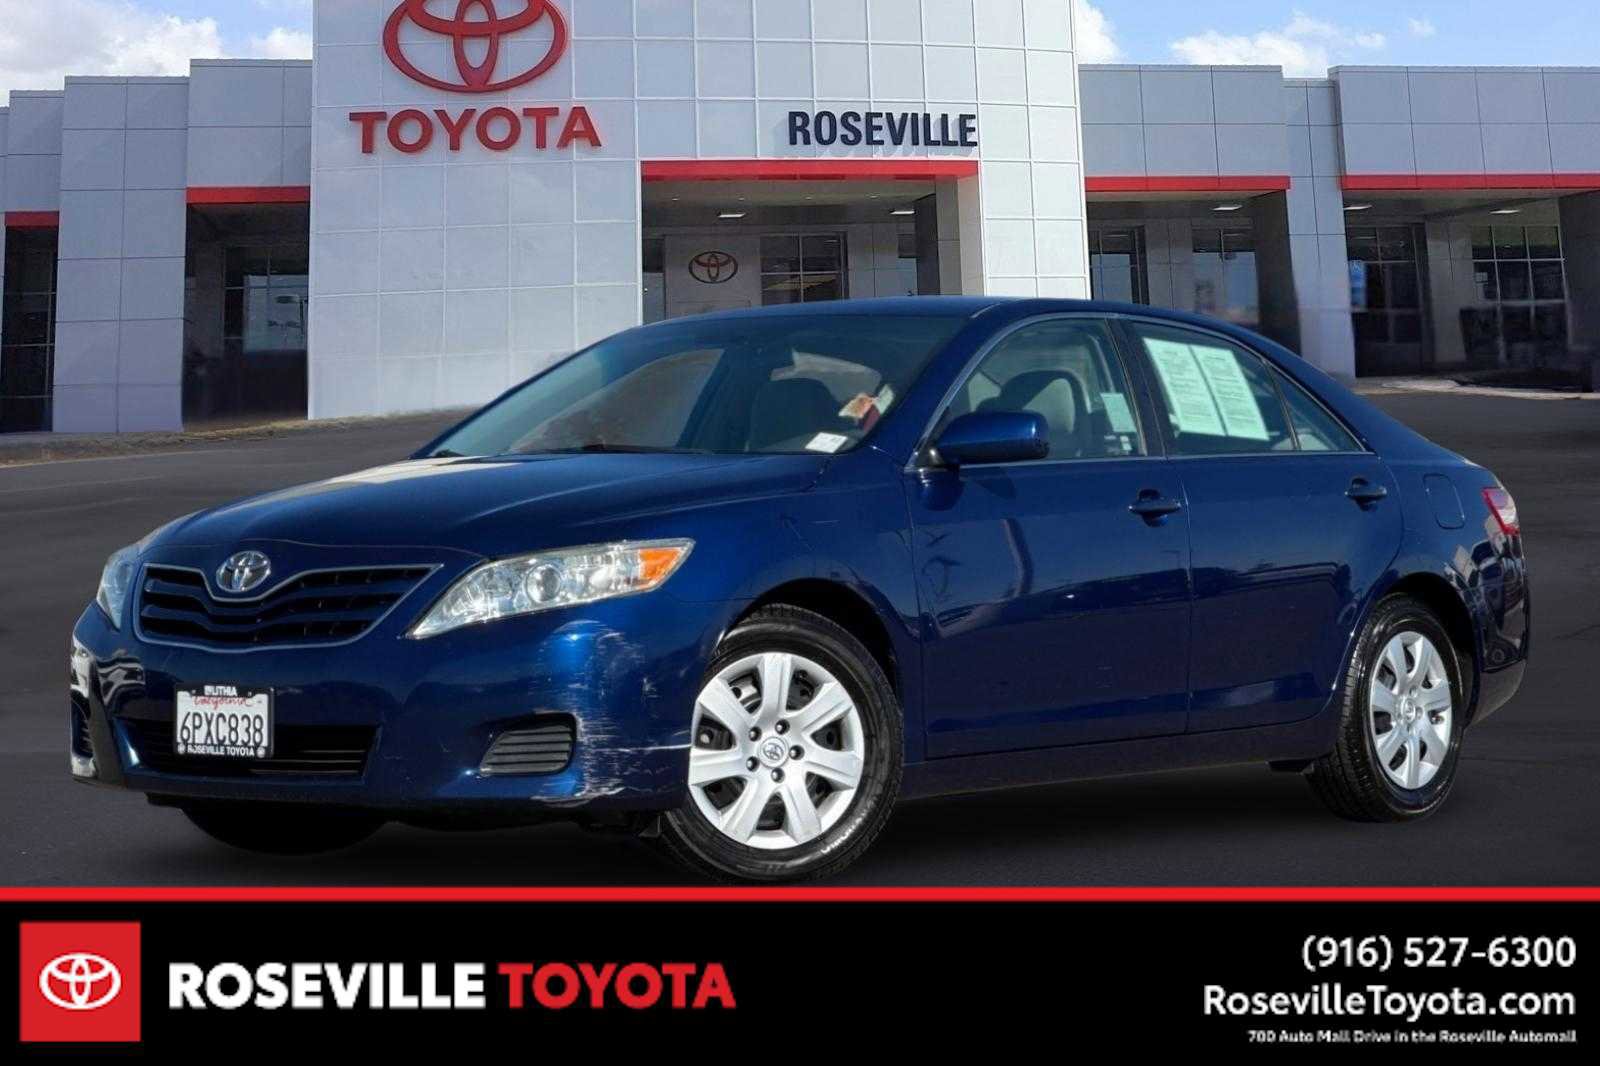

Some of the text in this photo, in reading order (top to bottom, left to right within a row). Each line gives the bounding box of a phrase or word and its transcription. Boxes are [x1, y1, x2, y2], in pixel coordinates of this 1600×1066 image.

[349, 106, 602, 154] TOYOTA
[788, 111, 978, 147] ROSEVILLE
[180, 711, 264, 747] 6PXC838
[187, 744, 255, 757] ROSEVILLE TOYOTA
